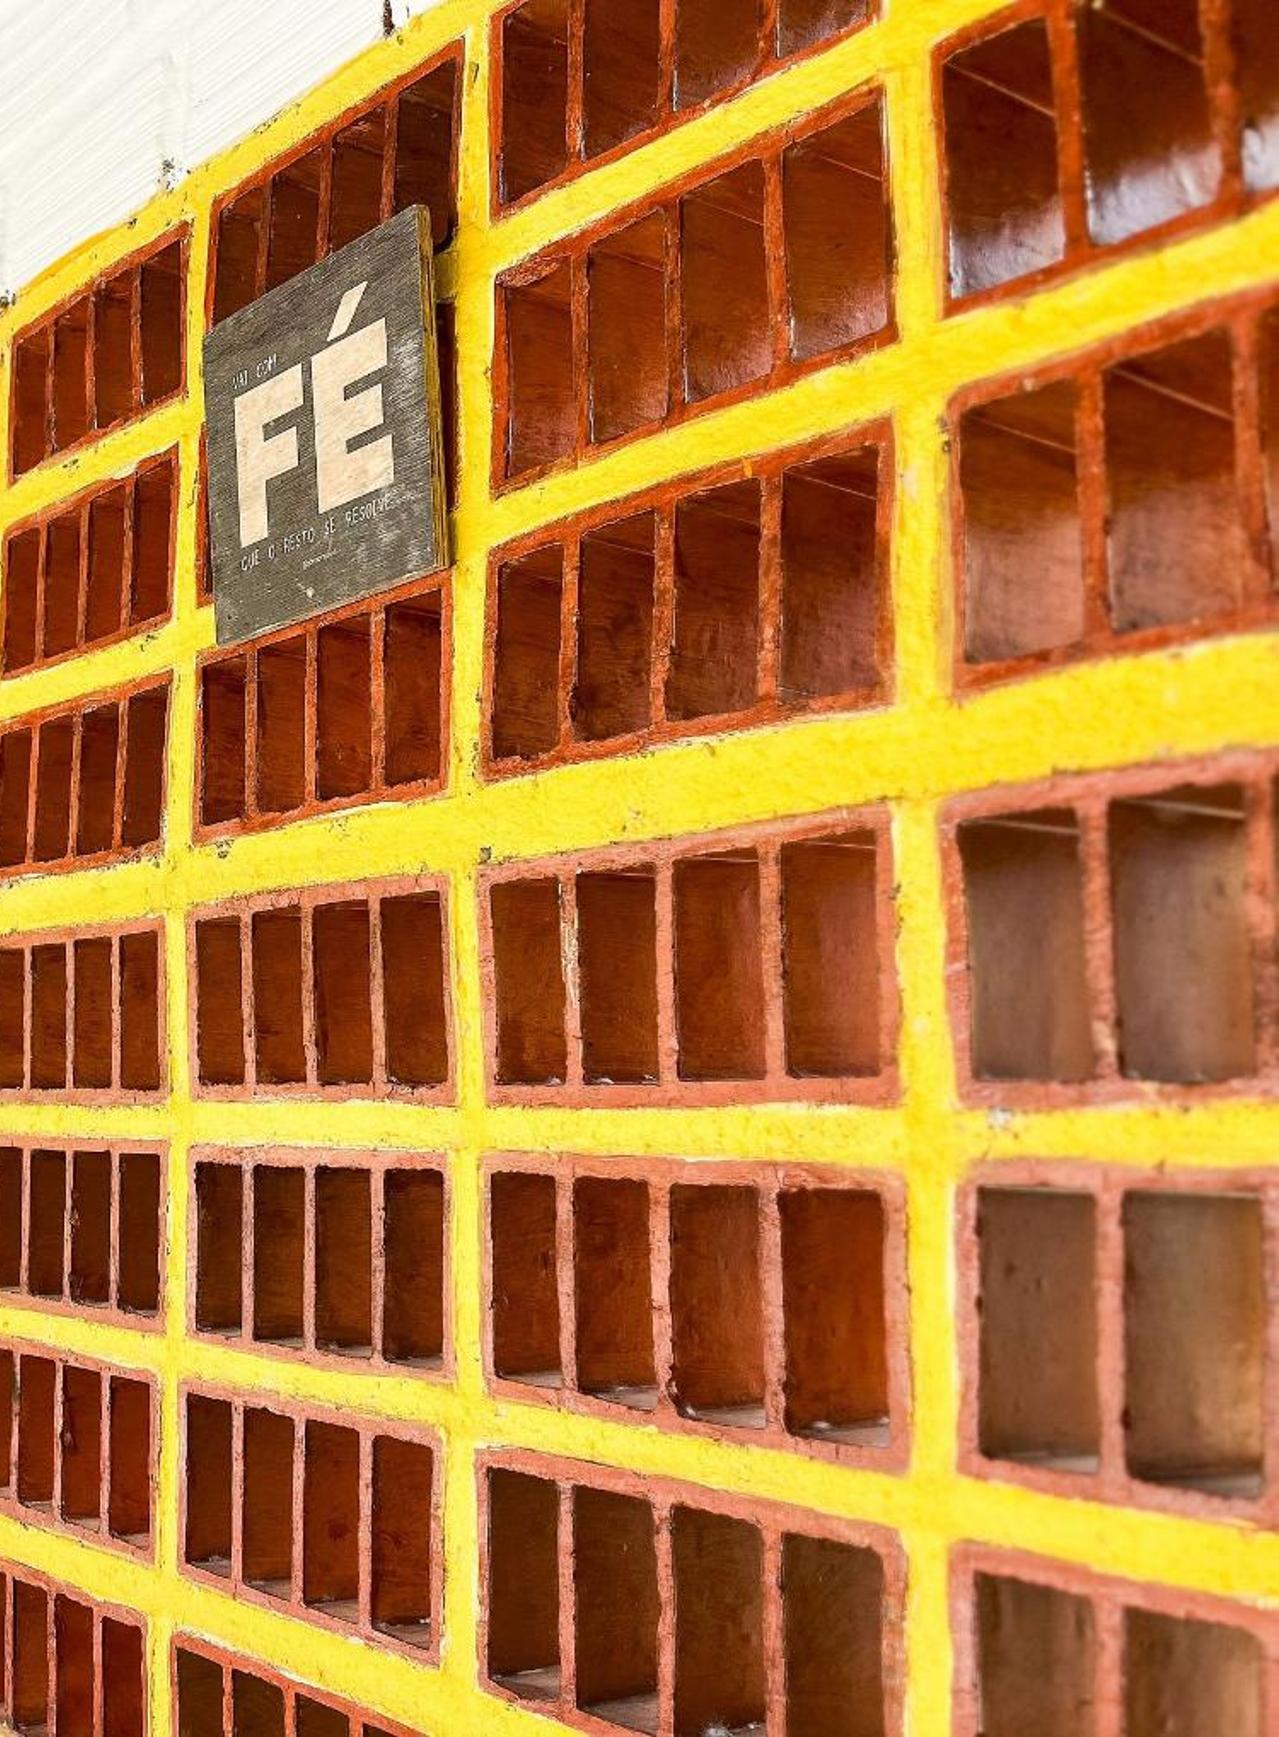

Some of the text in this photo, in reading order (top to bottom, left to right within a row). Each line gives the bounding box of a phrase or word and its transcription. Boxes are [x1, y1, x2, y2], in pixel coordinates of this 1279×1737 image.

[256, 352, 278, 378] COM
[233, 280, 395, 549] FÉ
[268, 544, 276, 561] O
[283, 526, 315, 554] RESTO
[324, 516, 336, 535] SE
